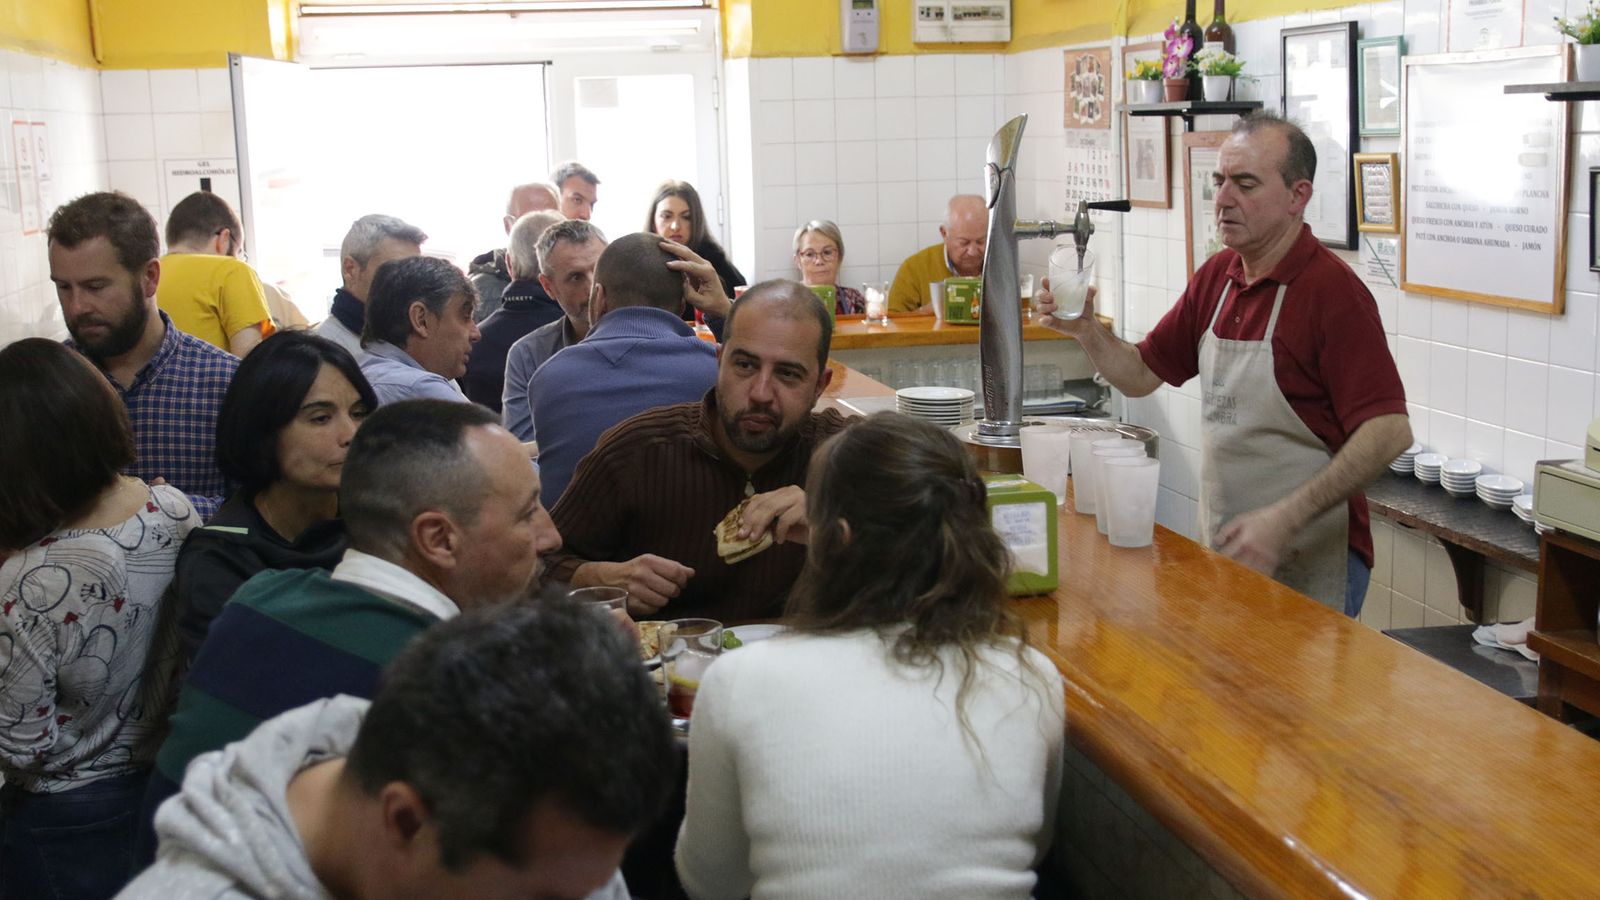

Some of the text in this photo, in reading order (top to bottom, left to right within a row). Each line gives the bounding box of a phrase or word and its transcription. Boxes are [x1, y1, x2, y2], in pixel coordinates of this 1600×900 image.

[1411, 216, 1425, 226] QUESO
[1426, 217, 1442, 226] FRESCO
[1443, 218, 1453, 227] CON
[1454, 219, 1474, 229] ANCHOA
[1504, 223, 1523, 233] QUESO
[1523, 224, 1548, 234] CURADO
[1426, 233, 1437, 241] CON
[1437, 234, 1456, 244] ANCHOA
[1461, 236, 1483, 247] SARDINA
[1484, 238, 1510, 249] AHUMADA
[1522, 240, 1541, 251] JAMÓN
